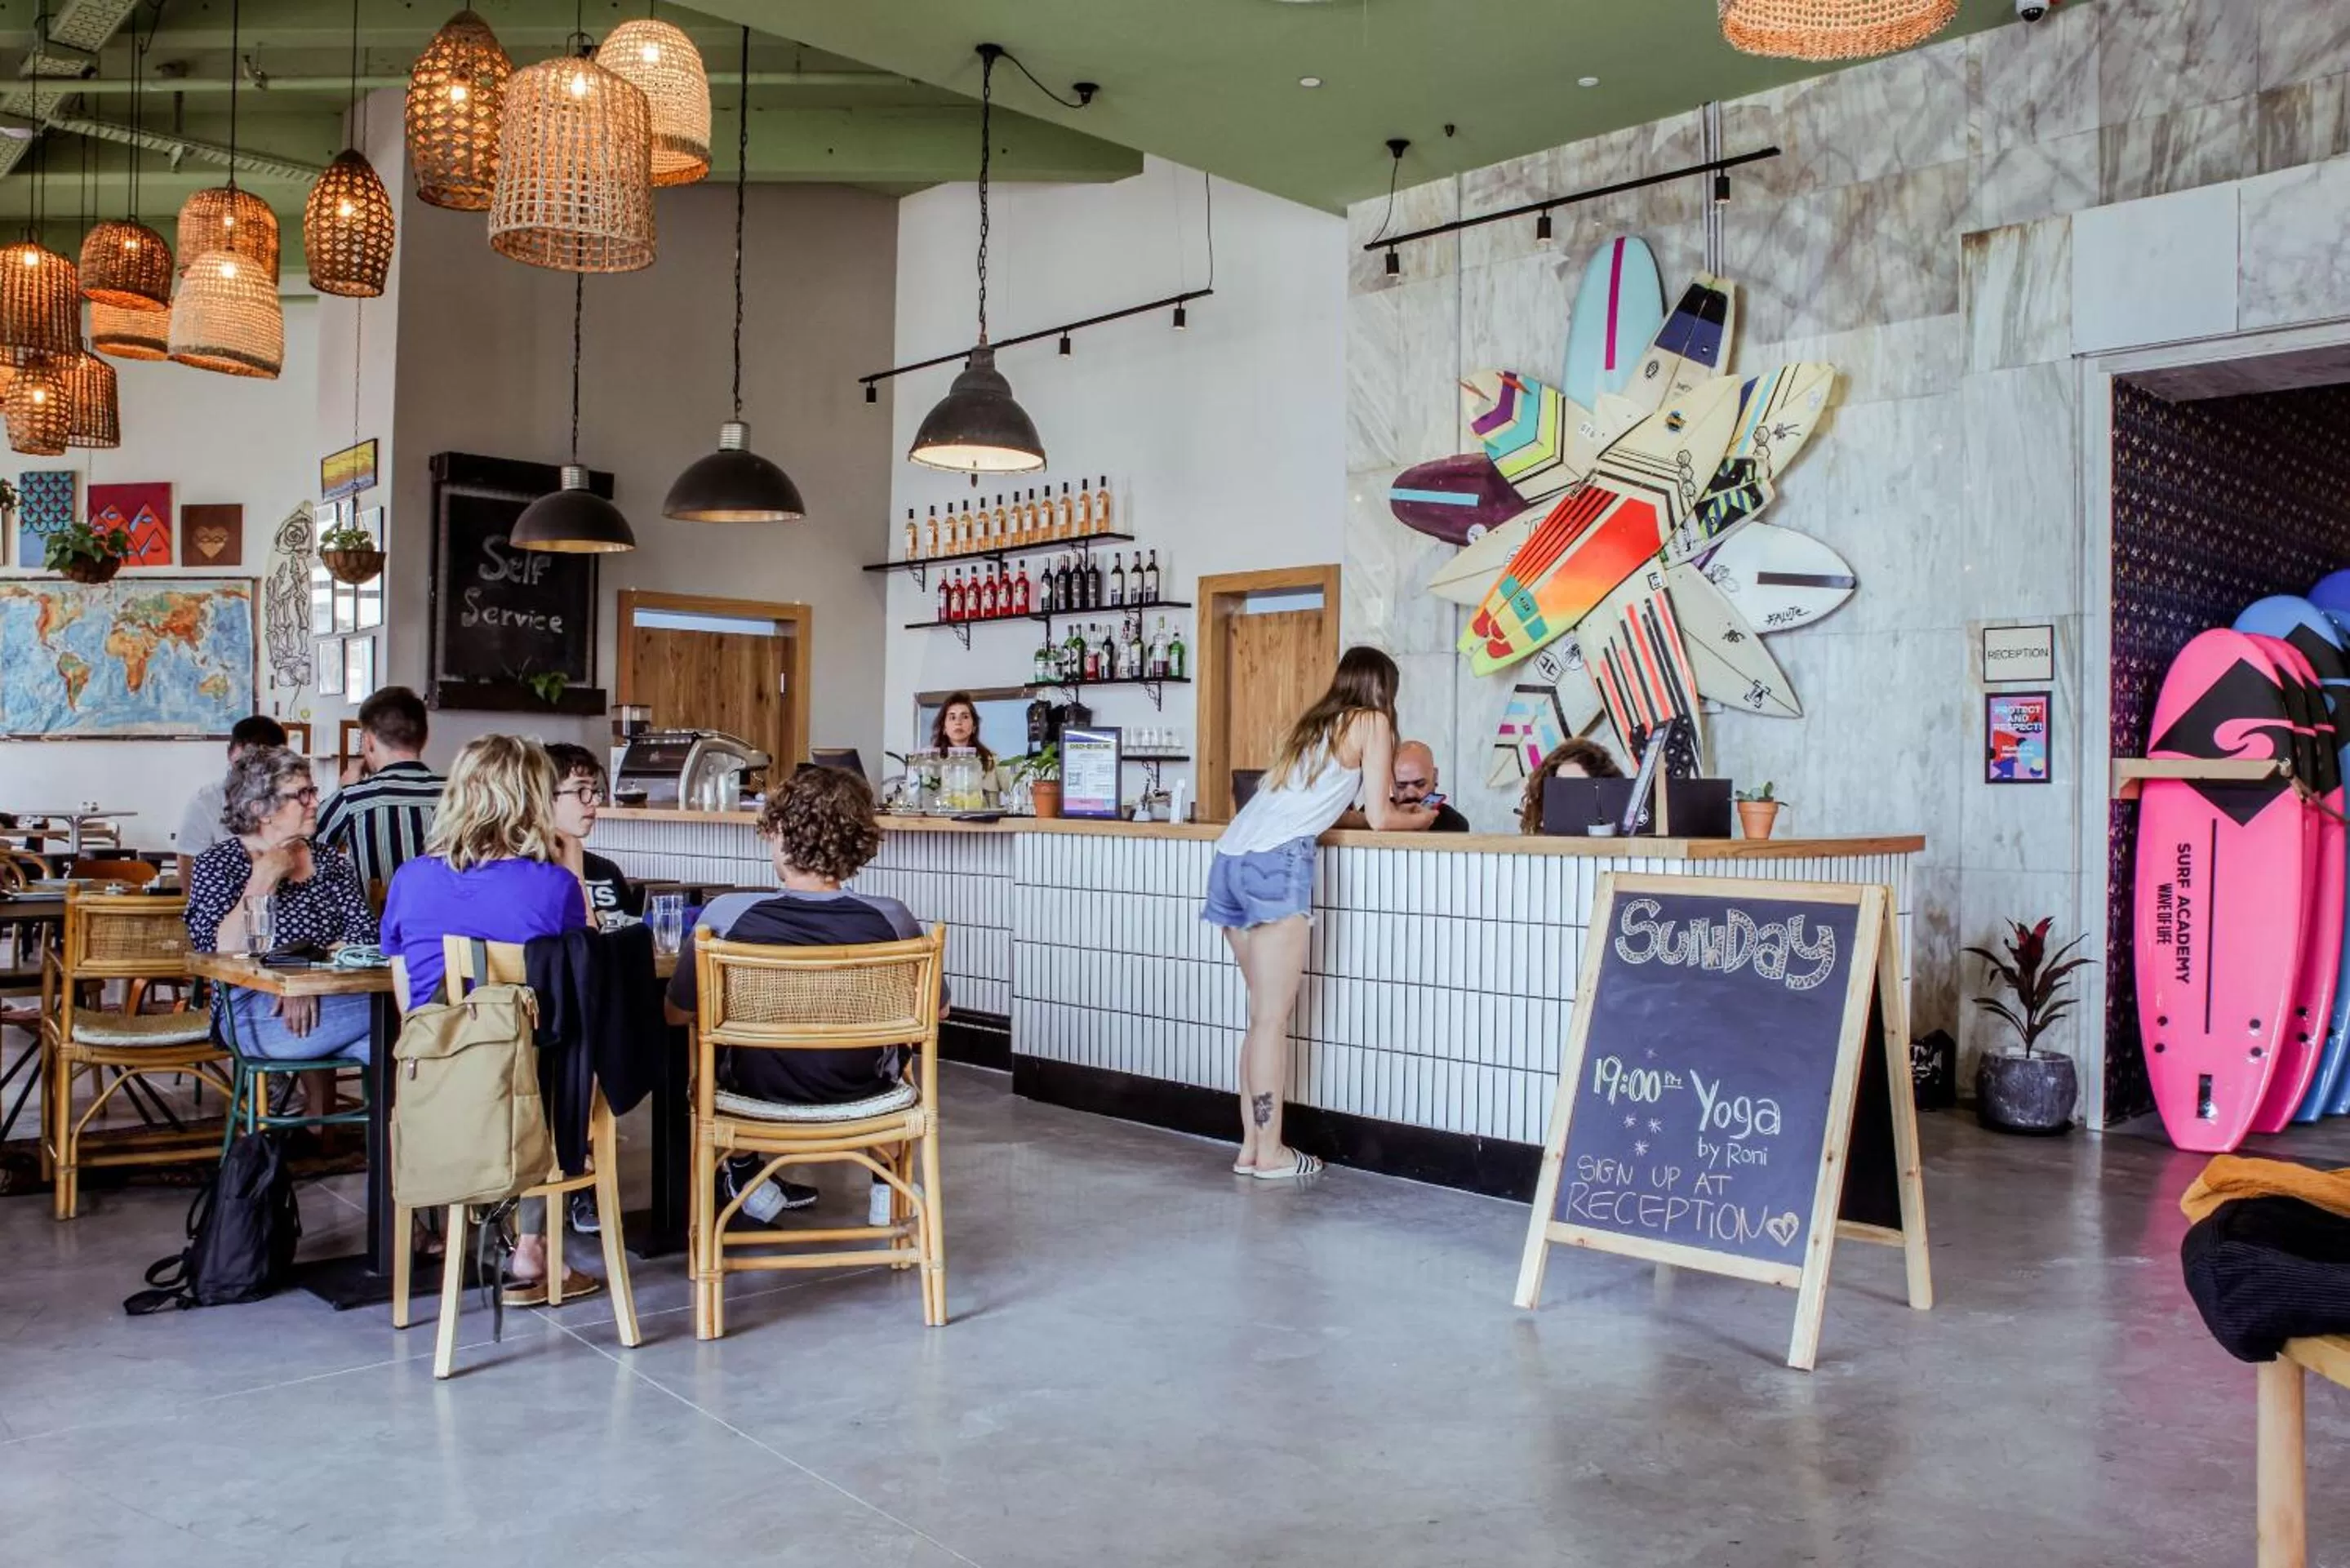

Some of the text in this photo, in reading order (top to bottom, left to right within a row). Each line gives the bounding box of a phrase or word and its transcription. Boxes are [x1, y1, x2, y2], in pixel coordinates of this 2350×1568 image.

[460, 587, 563, 634] Service
[1987, 647, 2049, 660] RECEPTION
[2157, 882, 2173, 945] WAVE OF LIFE
[2175, 842, 2192, 985] SURF ACADEMY
[1689, 1068, 1781, 1139] Yoga
[1577, 1155, 1733, 1196] SIGN UP AT
[1698, 1137, 1768, 1169] by Roni
